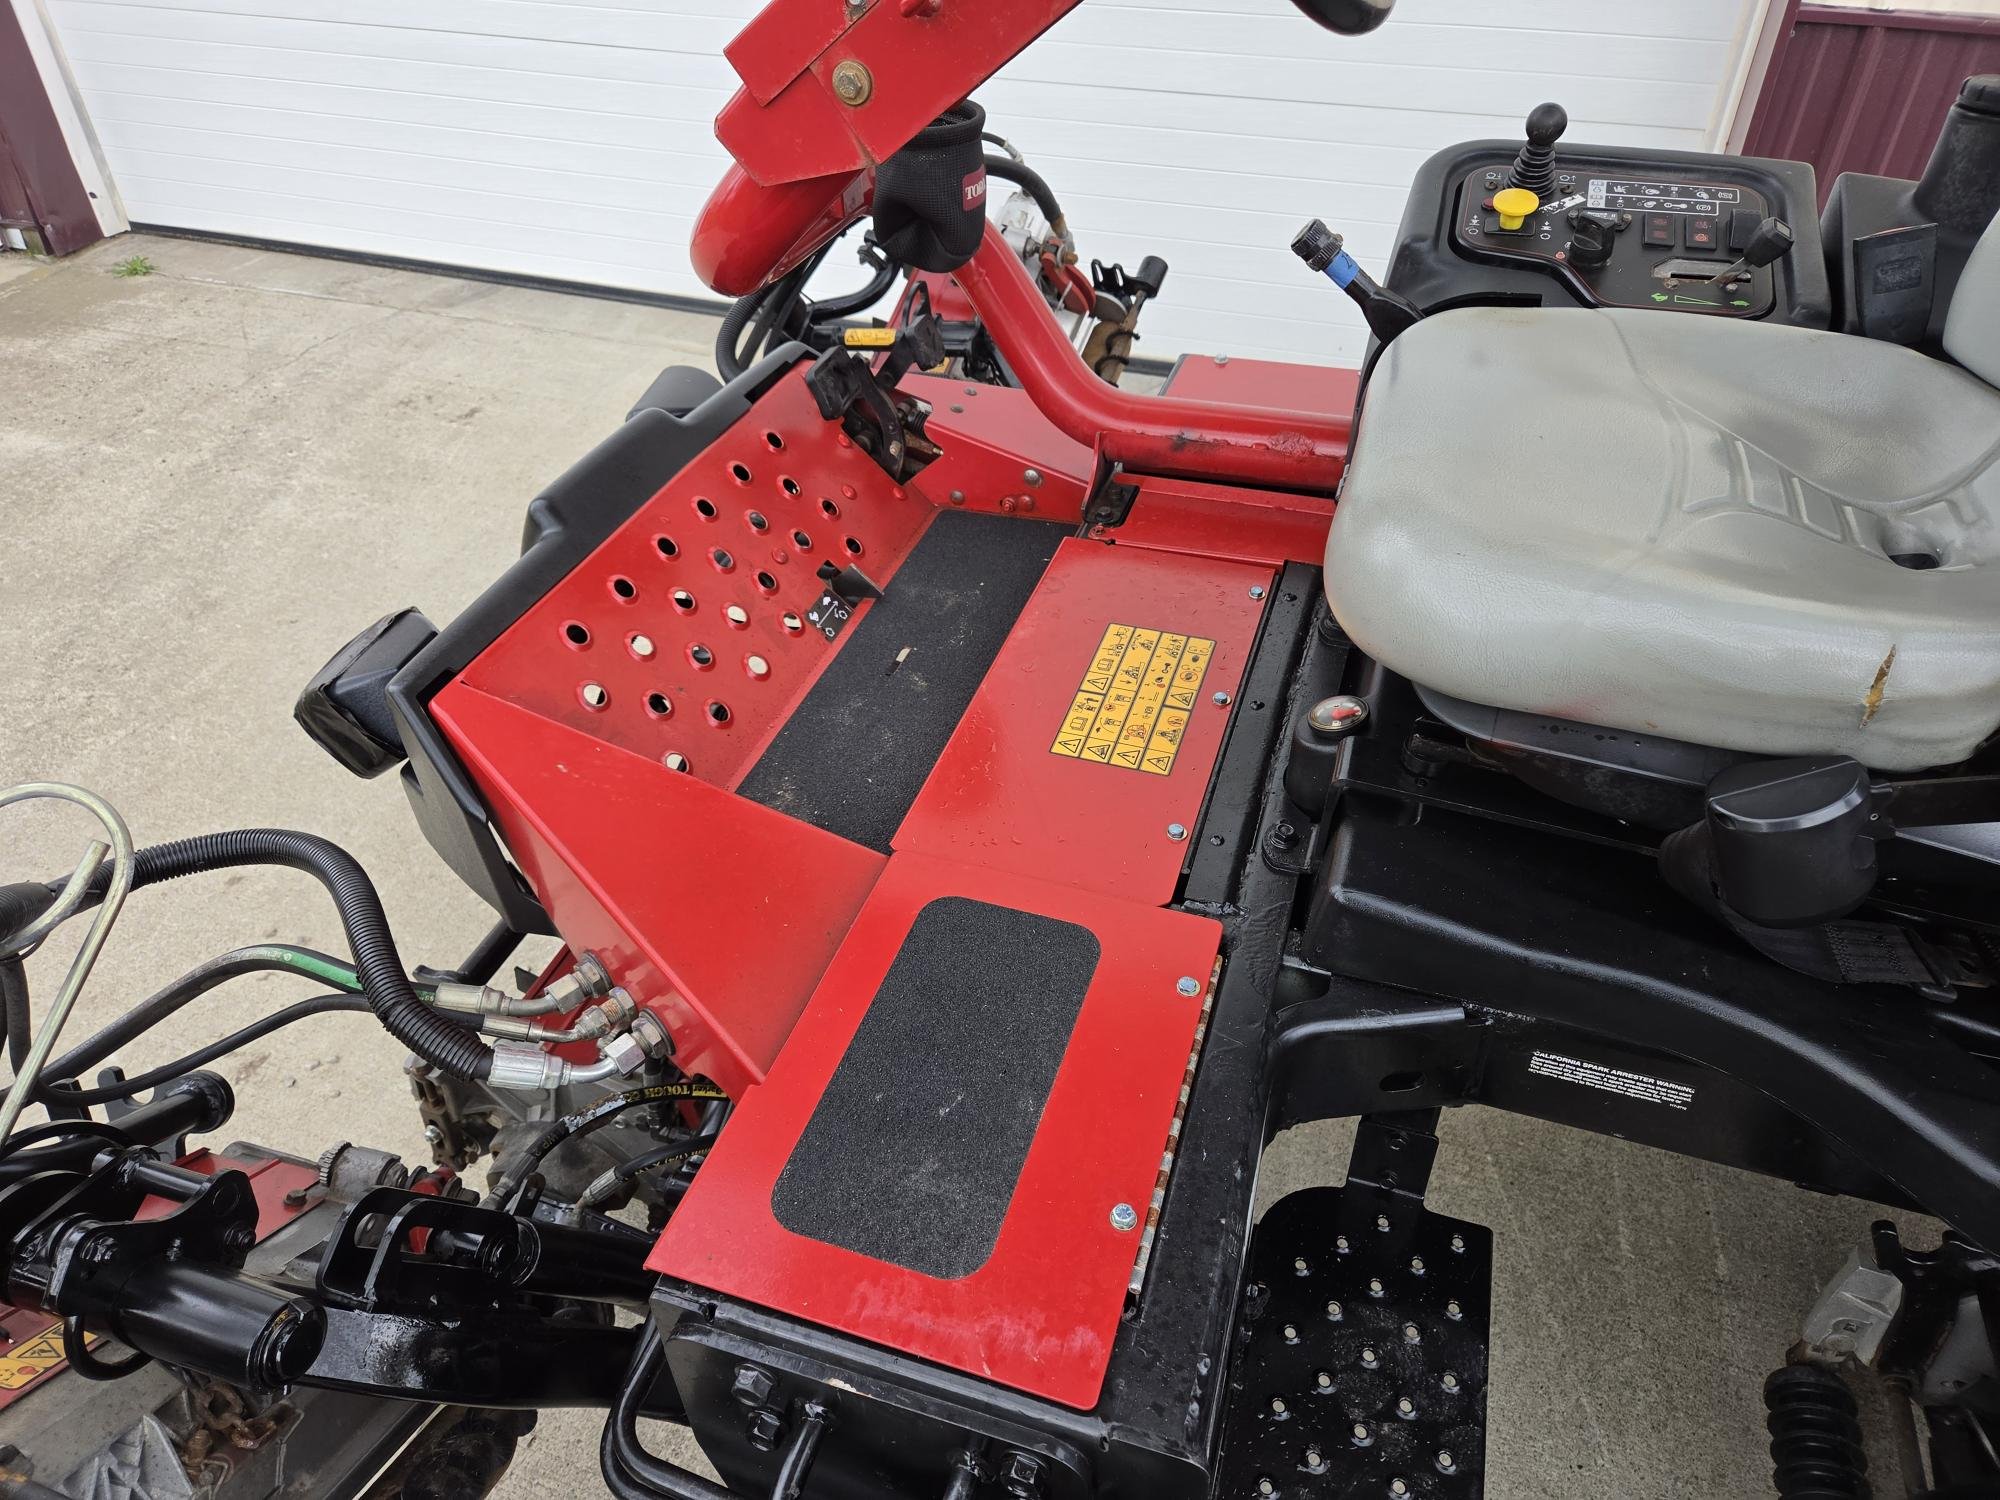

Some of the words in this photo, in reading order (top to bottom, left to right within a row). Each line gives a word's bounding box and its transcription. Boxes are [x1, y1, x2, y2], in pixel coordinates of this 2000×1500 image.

[1534, 1051, 1580, 1066] CALIFORNIA
[1582, 1063, 1610, 1073] SPARK
[1611, 1070, 1655, 1083] ARRESTER
[645, 1085, 690, 1098] TOUGH
